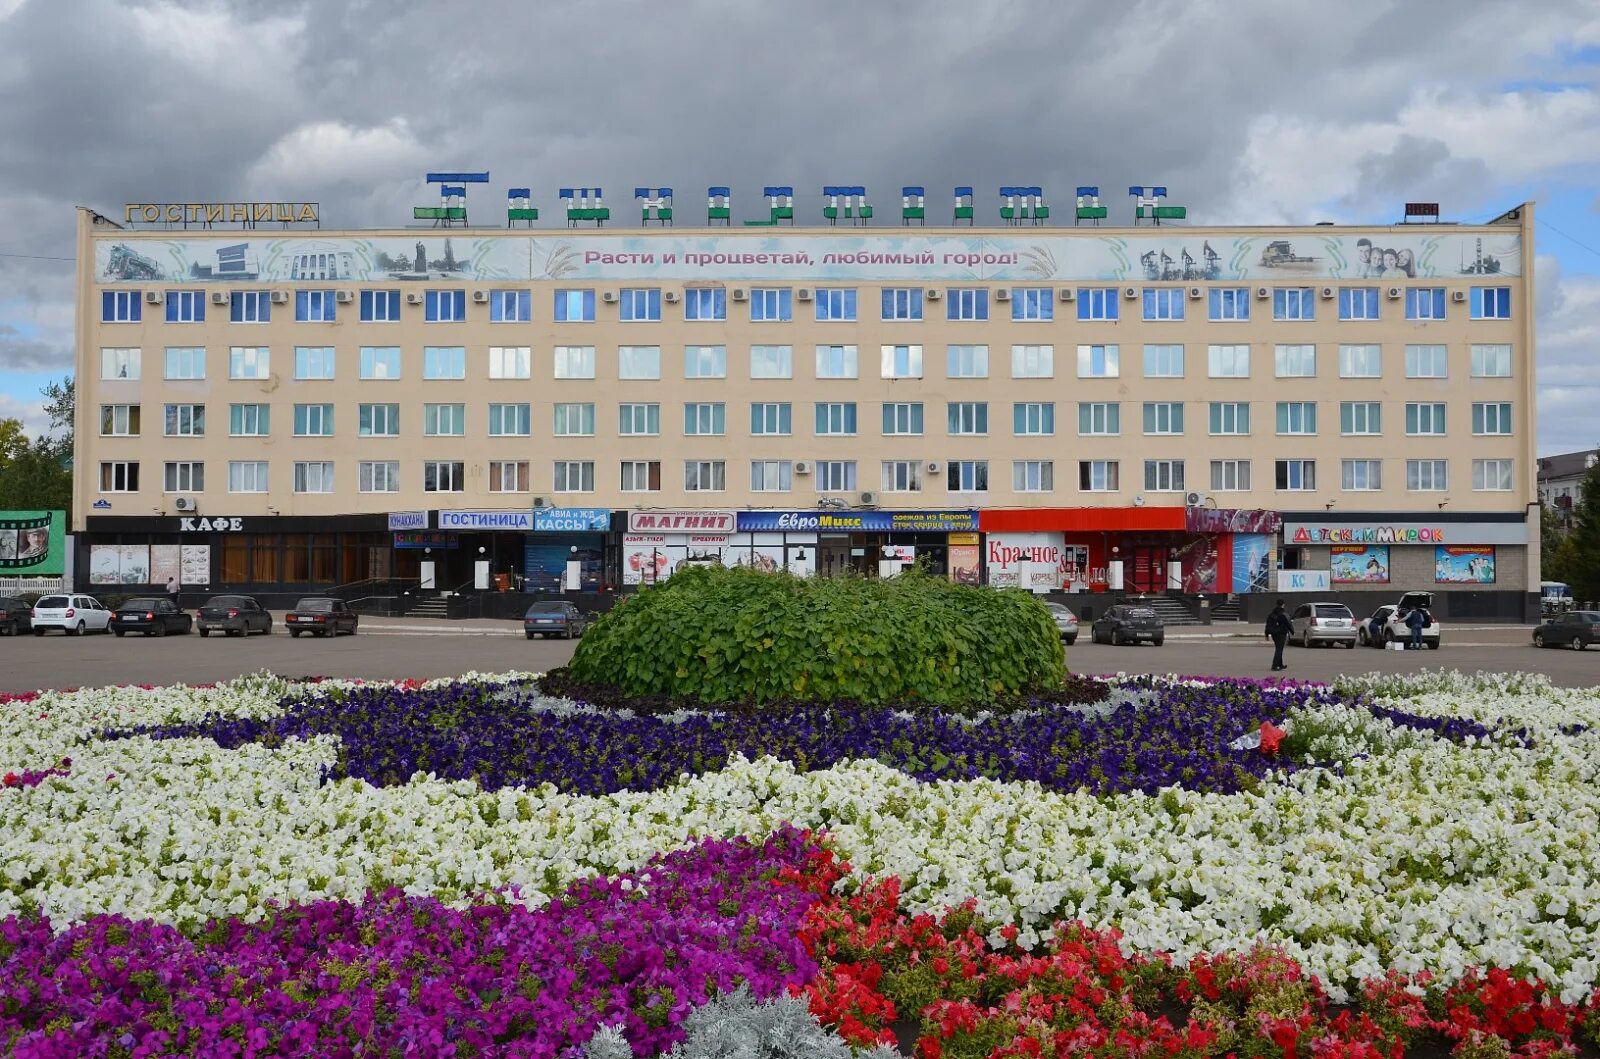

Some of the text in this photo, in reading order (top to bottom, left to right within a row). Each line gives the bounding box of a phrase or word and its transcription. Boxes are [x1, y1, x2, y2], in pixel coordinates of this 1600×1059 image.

[125, 203, 318, 222] ГОСТИНИЦА
[585, 250, 1018, 268] Расти и процветай, любимый город!
[442, 513, 528, 528] ГОСТИНИЦА
[550, 510, 571, 519] АВИА
[180, 517, 243, 531] КАФЕ
[536, 519, 586, 530] КАССЫ
[636, 516, 729, 528] МАГНИТ
[1293, 526, 1445, 542] ДЕТСКИЙ МИРОК
